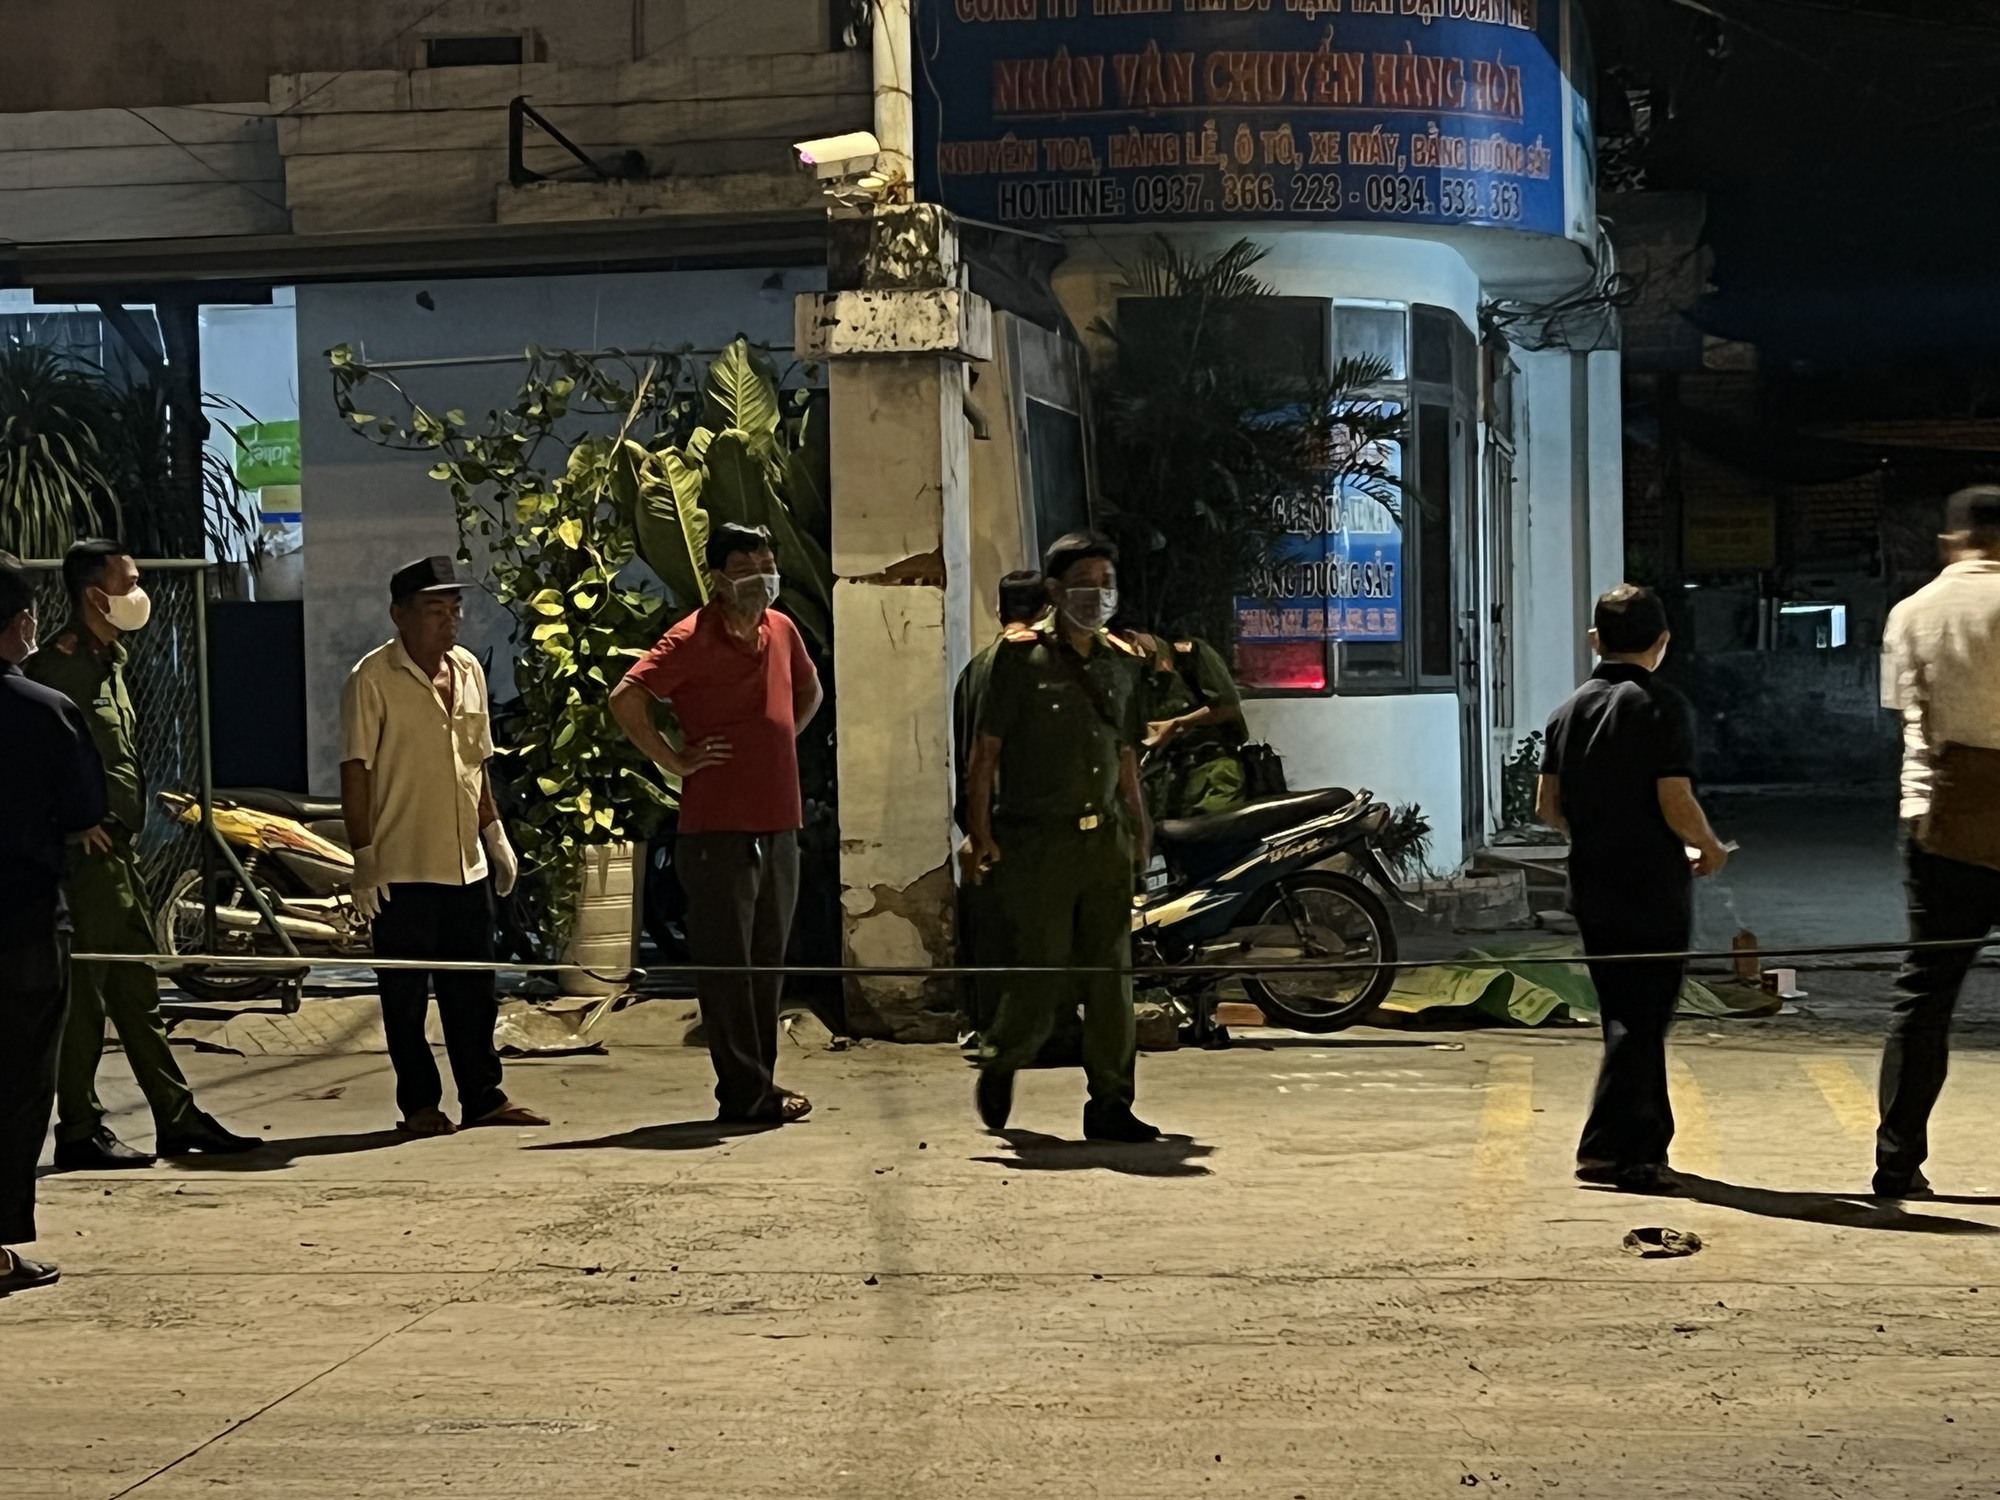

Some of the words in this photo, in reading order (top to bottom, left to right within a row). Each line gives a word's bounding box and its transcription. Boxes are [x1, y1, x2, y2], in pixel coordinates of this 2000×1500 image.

[1113, 38, 1195, 117] VẬN
[1204, 24, 1364, 105] CHUYỂN
[1373, 40, 1466, 108] HÀNG
[939, 131, 1037, 175] NGUYÊN
[1107, 126, 1180, 168] HÀNG
[1186, 119, 1229, 171] LẺ,
[1234, 123, 1254, 165] Ô
[1260, 122, 1303, 170] TÔ,
[1308, 130, 1341, 165] XE
[1348, 124, 1406, 173] MÁY,
[1000, 177, 1125, 221] HOTLINE:
[1132, 174, 1214, 214] 0937.
[1221, 173, 1284, 213] 366.
[1291, 173, 1342, 212] 223
[1365, 175, 1435, 214] 0934.
[1489, 180, 1522, 220] 363
